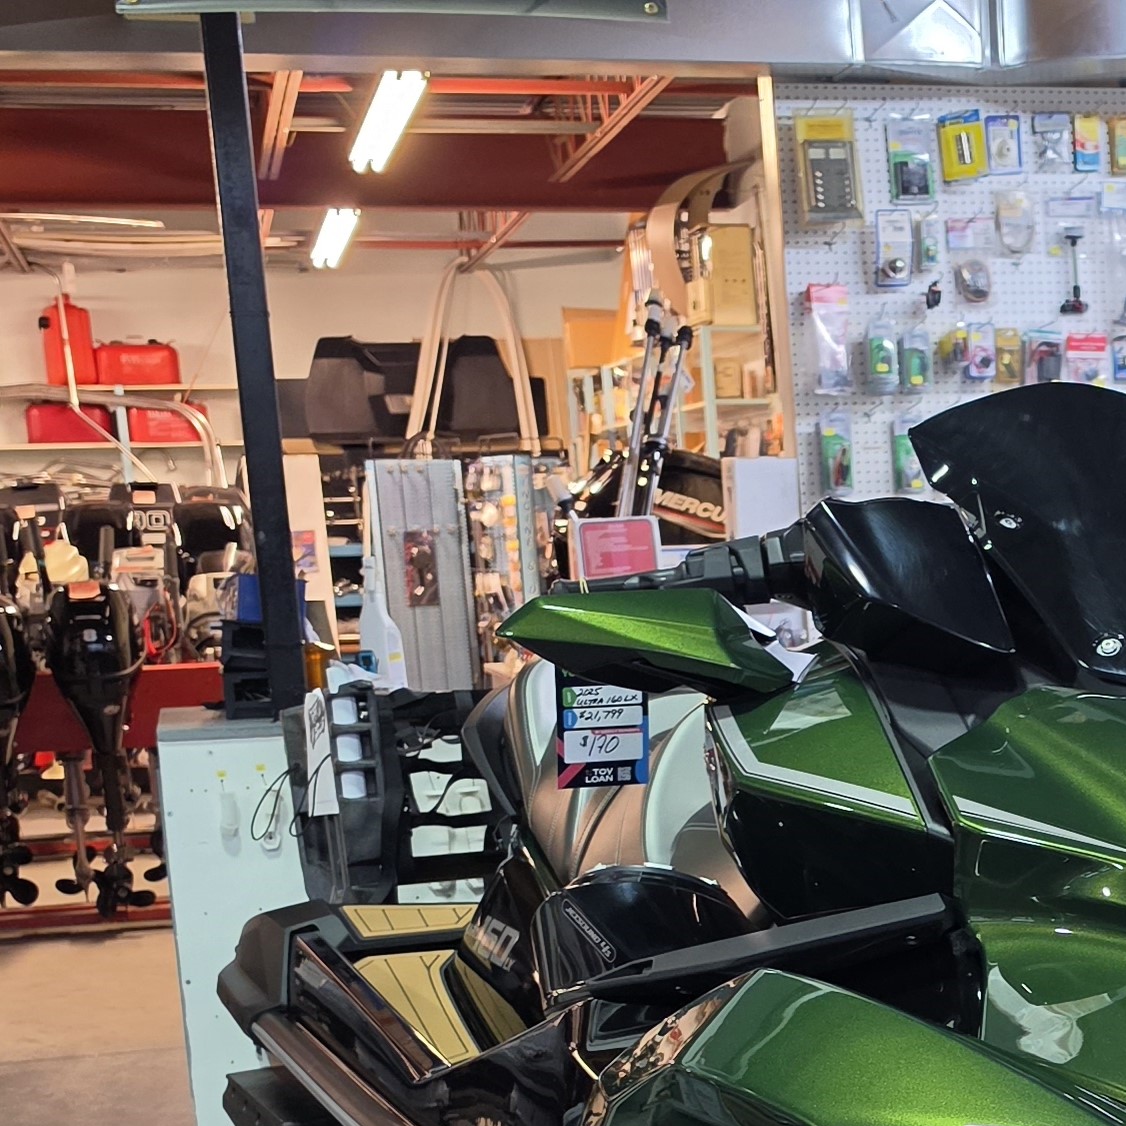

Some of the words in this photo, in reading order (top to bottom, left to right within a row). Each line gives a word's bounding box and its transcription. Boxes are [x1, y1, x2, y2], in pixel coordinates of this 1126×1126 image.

[654, 488, 728, 523] MERCU
[576, 687, 602, 697] 2025
[576, 697, 604, 706] ULTRA
[579, 708, 624, 721] $21,799
[580, 734, 620, 756] $170
[592, 767, 613, 776] TOY
[585, 775, 613, 784] LOAN
